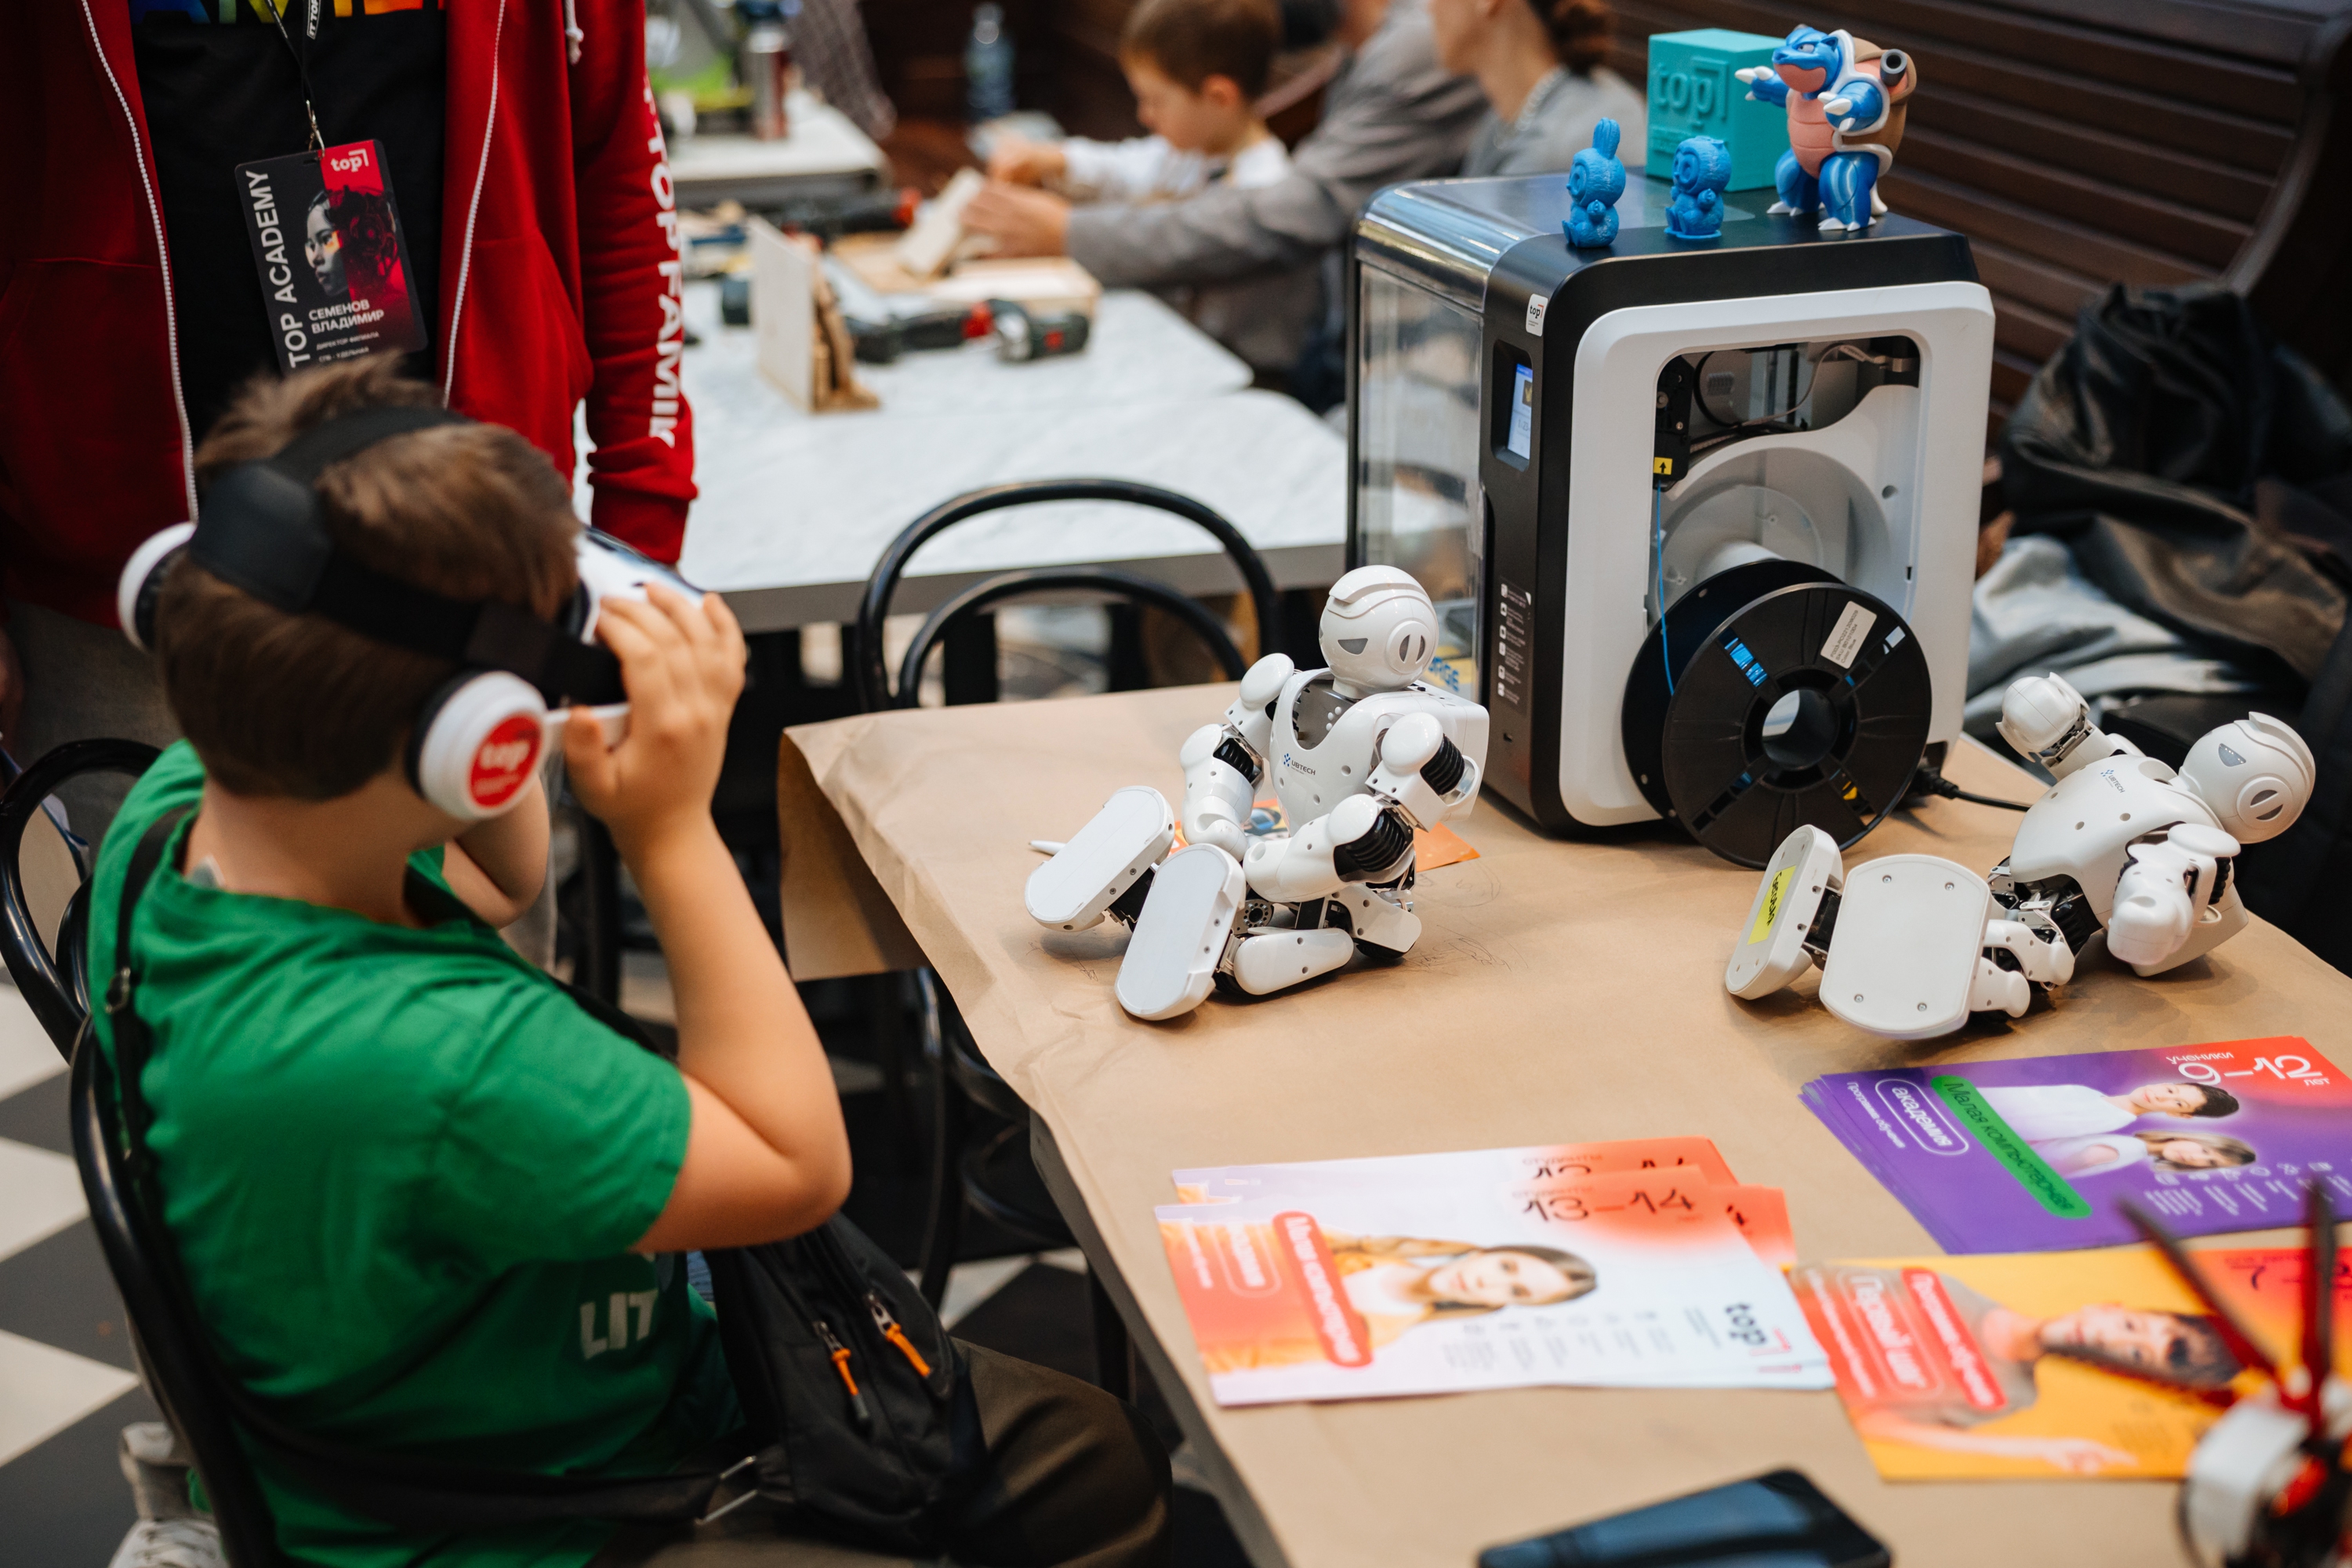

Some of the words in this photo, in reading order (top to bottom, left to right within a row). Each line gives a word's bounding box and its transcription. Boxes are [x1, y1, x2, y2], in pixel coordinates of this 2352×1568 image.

[1651, 61, 1712, 125] top
[330, 150, 367, 172] top
[245, 170, 298, 303] ACADEMY
[308, 299, 370, 321] СЕМЕНОВ
[311, 309, 384, 334] ВЛАДИМИР
[1530, 305, 1541, 319] top
[278, 313, 311, 368] TOP
[1291, 760, 1316, 775] UBTECH
[2108, 775, 2125, 793] UBTECH
[1944, 1083, 1988, 1123] Малая
[1892, 1087, 1953, 1146] академия
